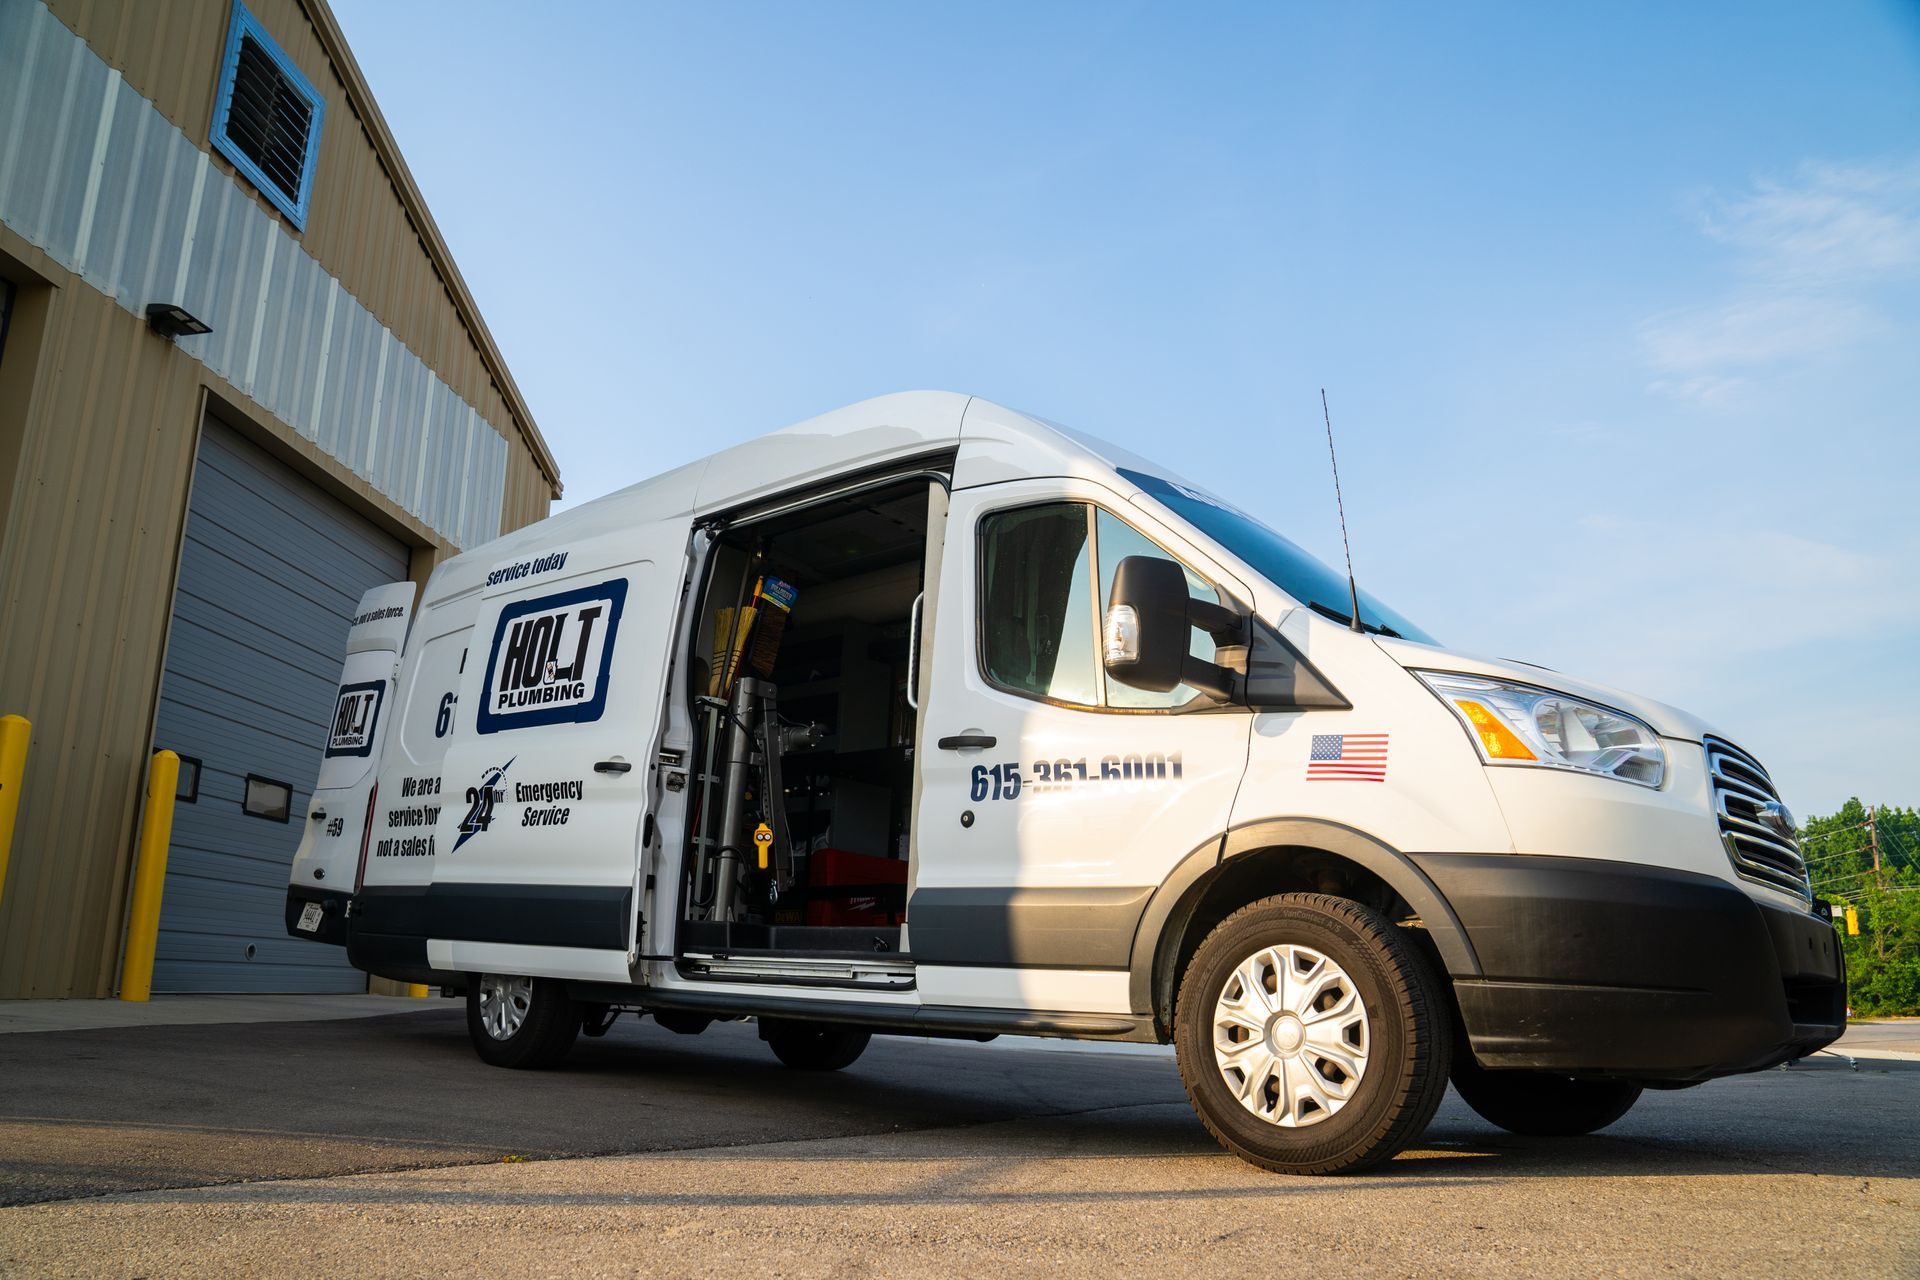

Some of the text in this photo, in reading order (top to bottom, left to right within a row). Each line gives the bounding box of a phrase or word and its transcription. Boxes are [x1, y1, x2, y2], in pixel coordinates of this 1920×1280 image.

[486, 552, 569, 587] service today
[370, 608, 386, 622] sales
[385, 606, 404, 619] force.
[499, 605, 603, 693] HOLT
[497, 682, 585, 709] PLUMBING
[334, 693, 375, 737] HOLT
[331, 736, 364, 746] PLUMBING
[402, 777, 441, 797] We are a
[970, 750, 1183, 802] 615-361-6001
[515, 780, 583, 803] Emergency
[326, 817, 344, 837] #59
[388, 804, 441, 828] service for
[521, 805, 571, 827] Service
[377, 838, 393, 857] not
[393, 839, 400, 857] a
[400, 835, 427, 857] sales
